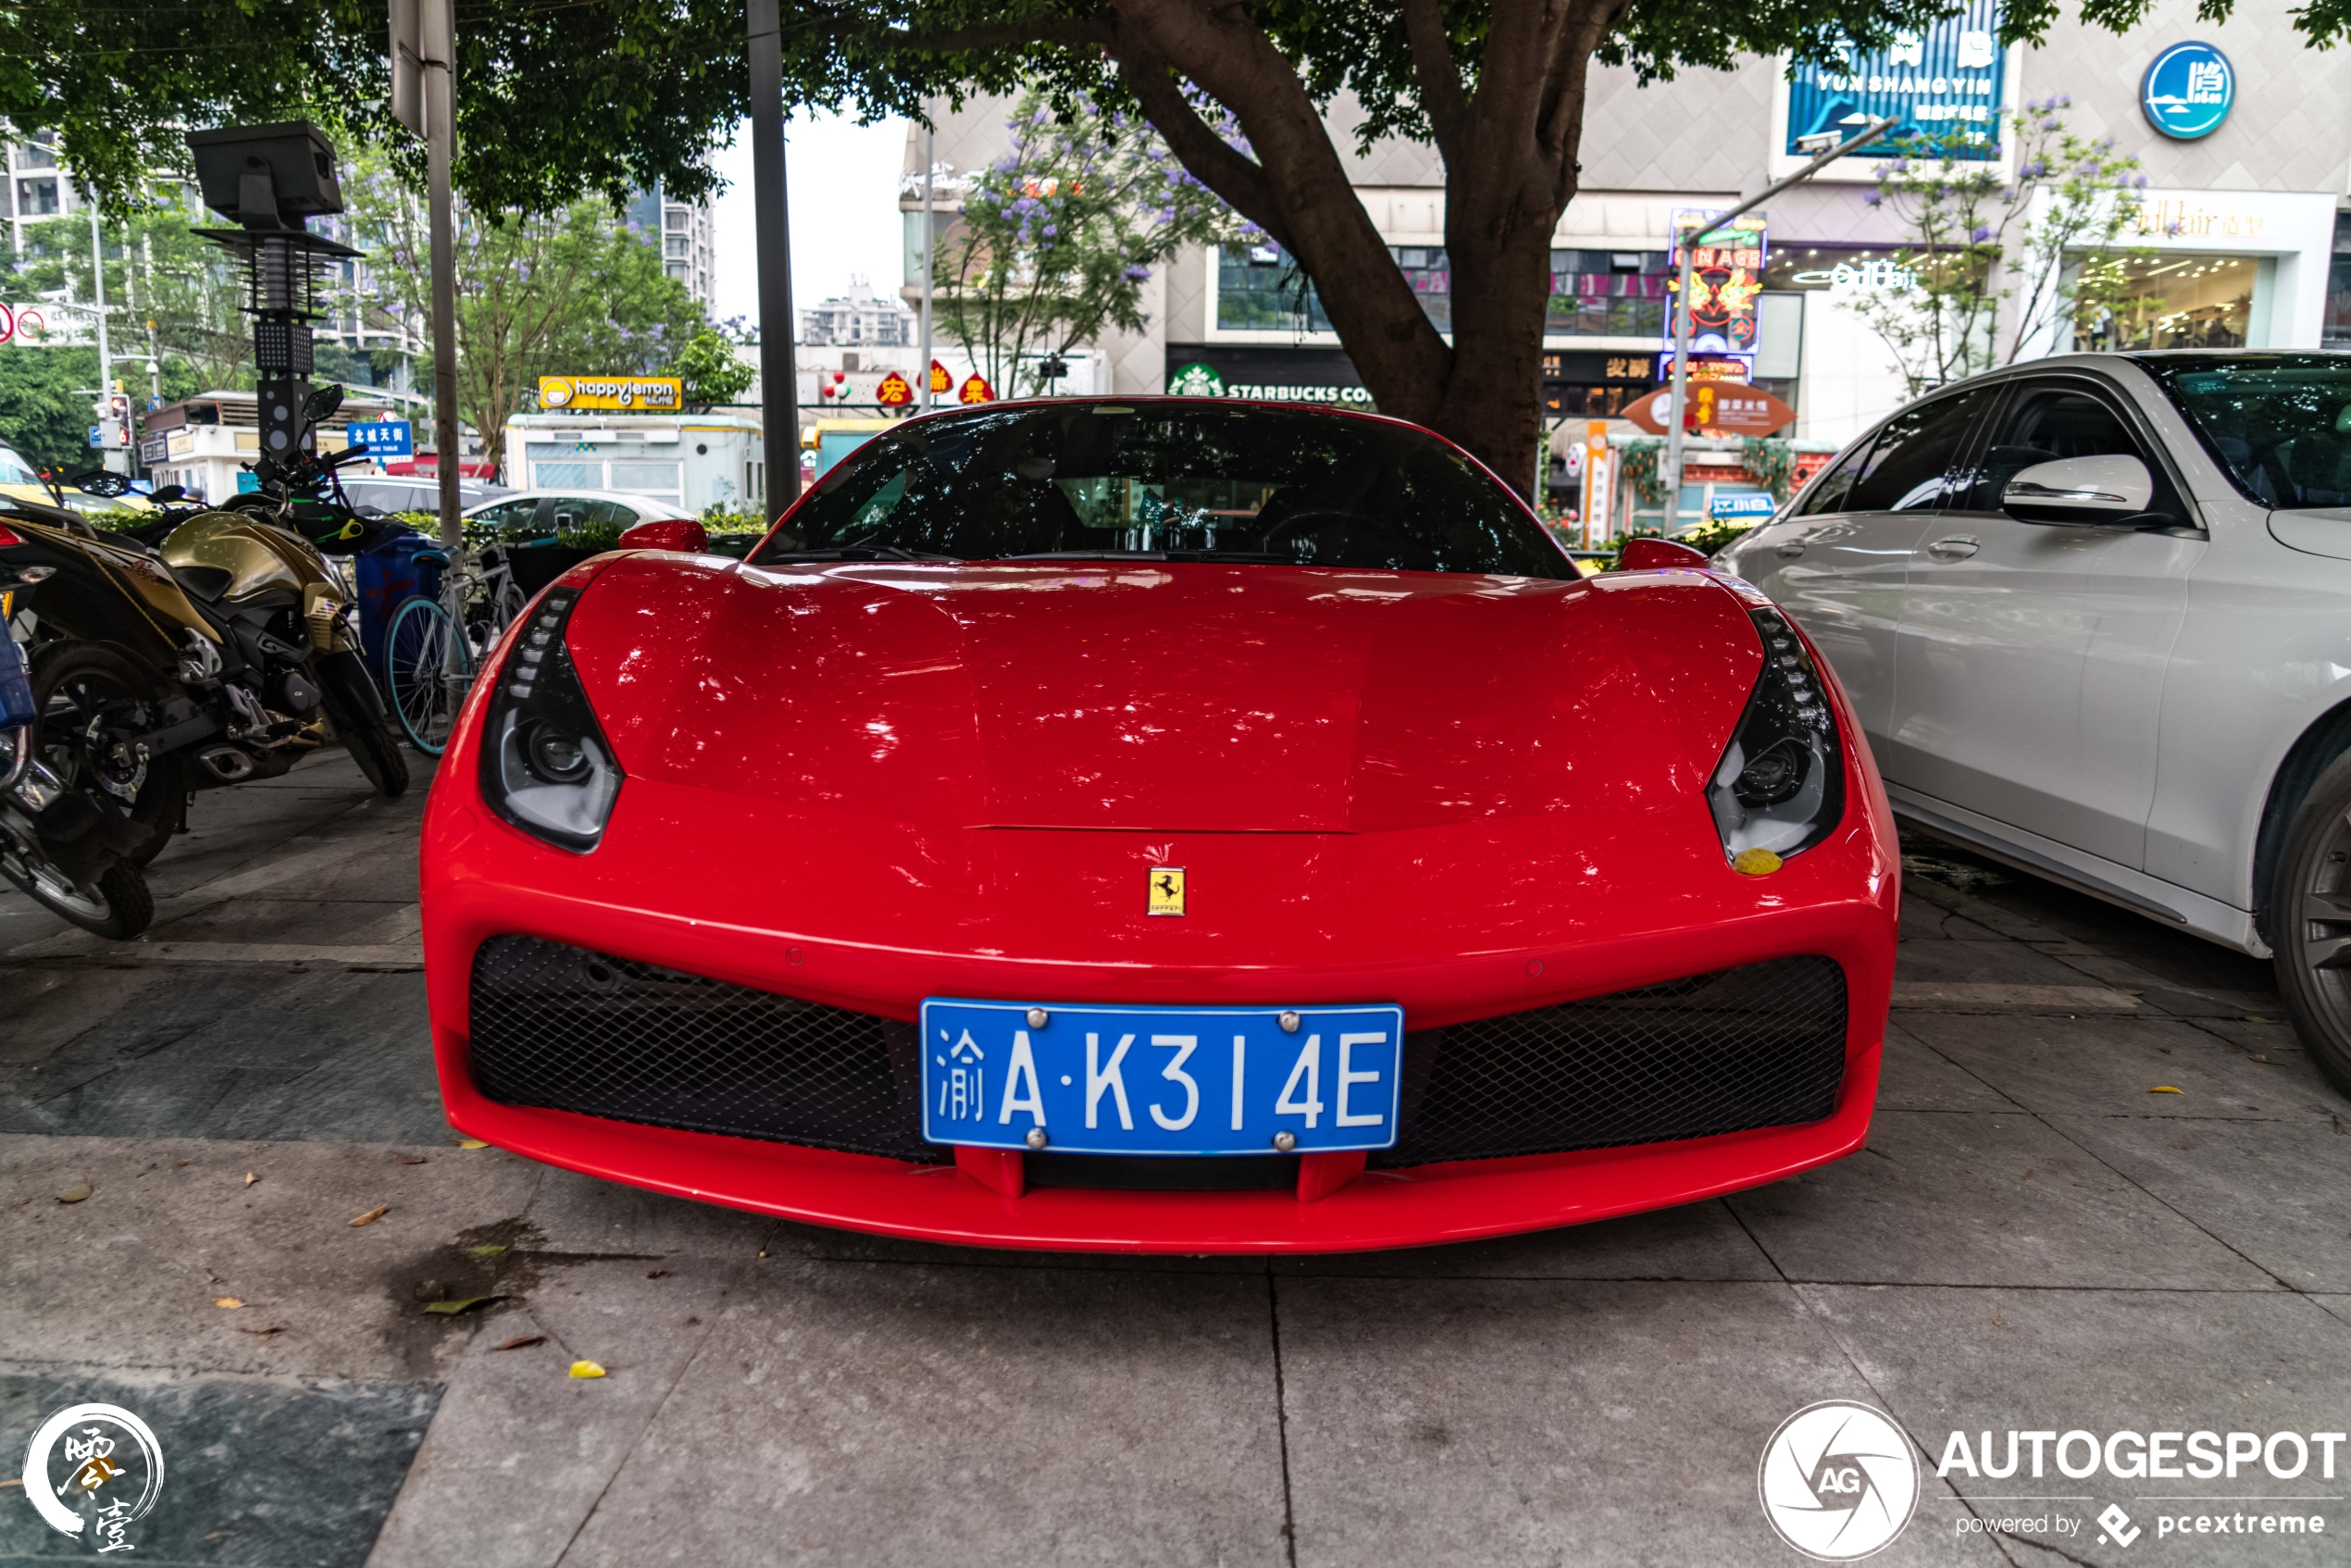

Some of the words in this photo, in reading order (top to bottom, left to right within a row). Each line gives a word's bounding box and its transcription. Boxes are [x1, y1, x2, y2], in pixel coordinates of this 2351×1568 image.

[1817, 73, 1864, 92] YUN
[1868, 75, 1947, 94] SHANG
[1952, 78, 1991, 95] YIN
[1227, 384, 1338, 402] STARBUCKS
[355, 428, 404, 443] 北城天街
